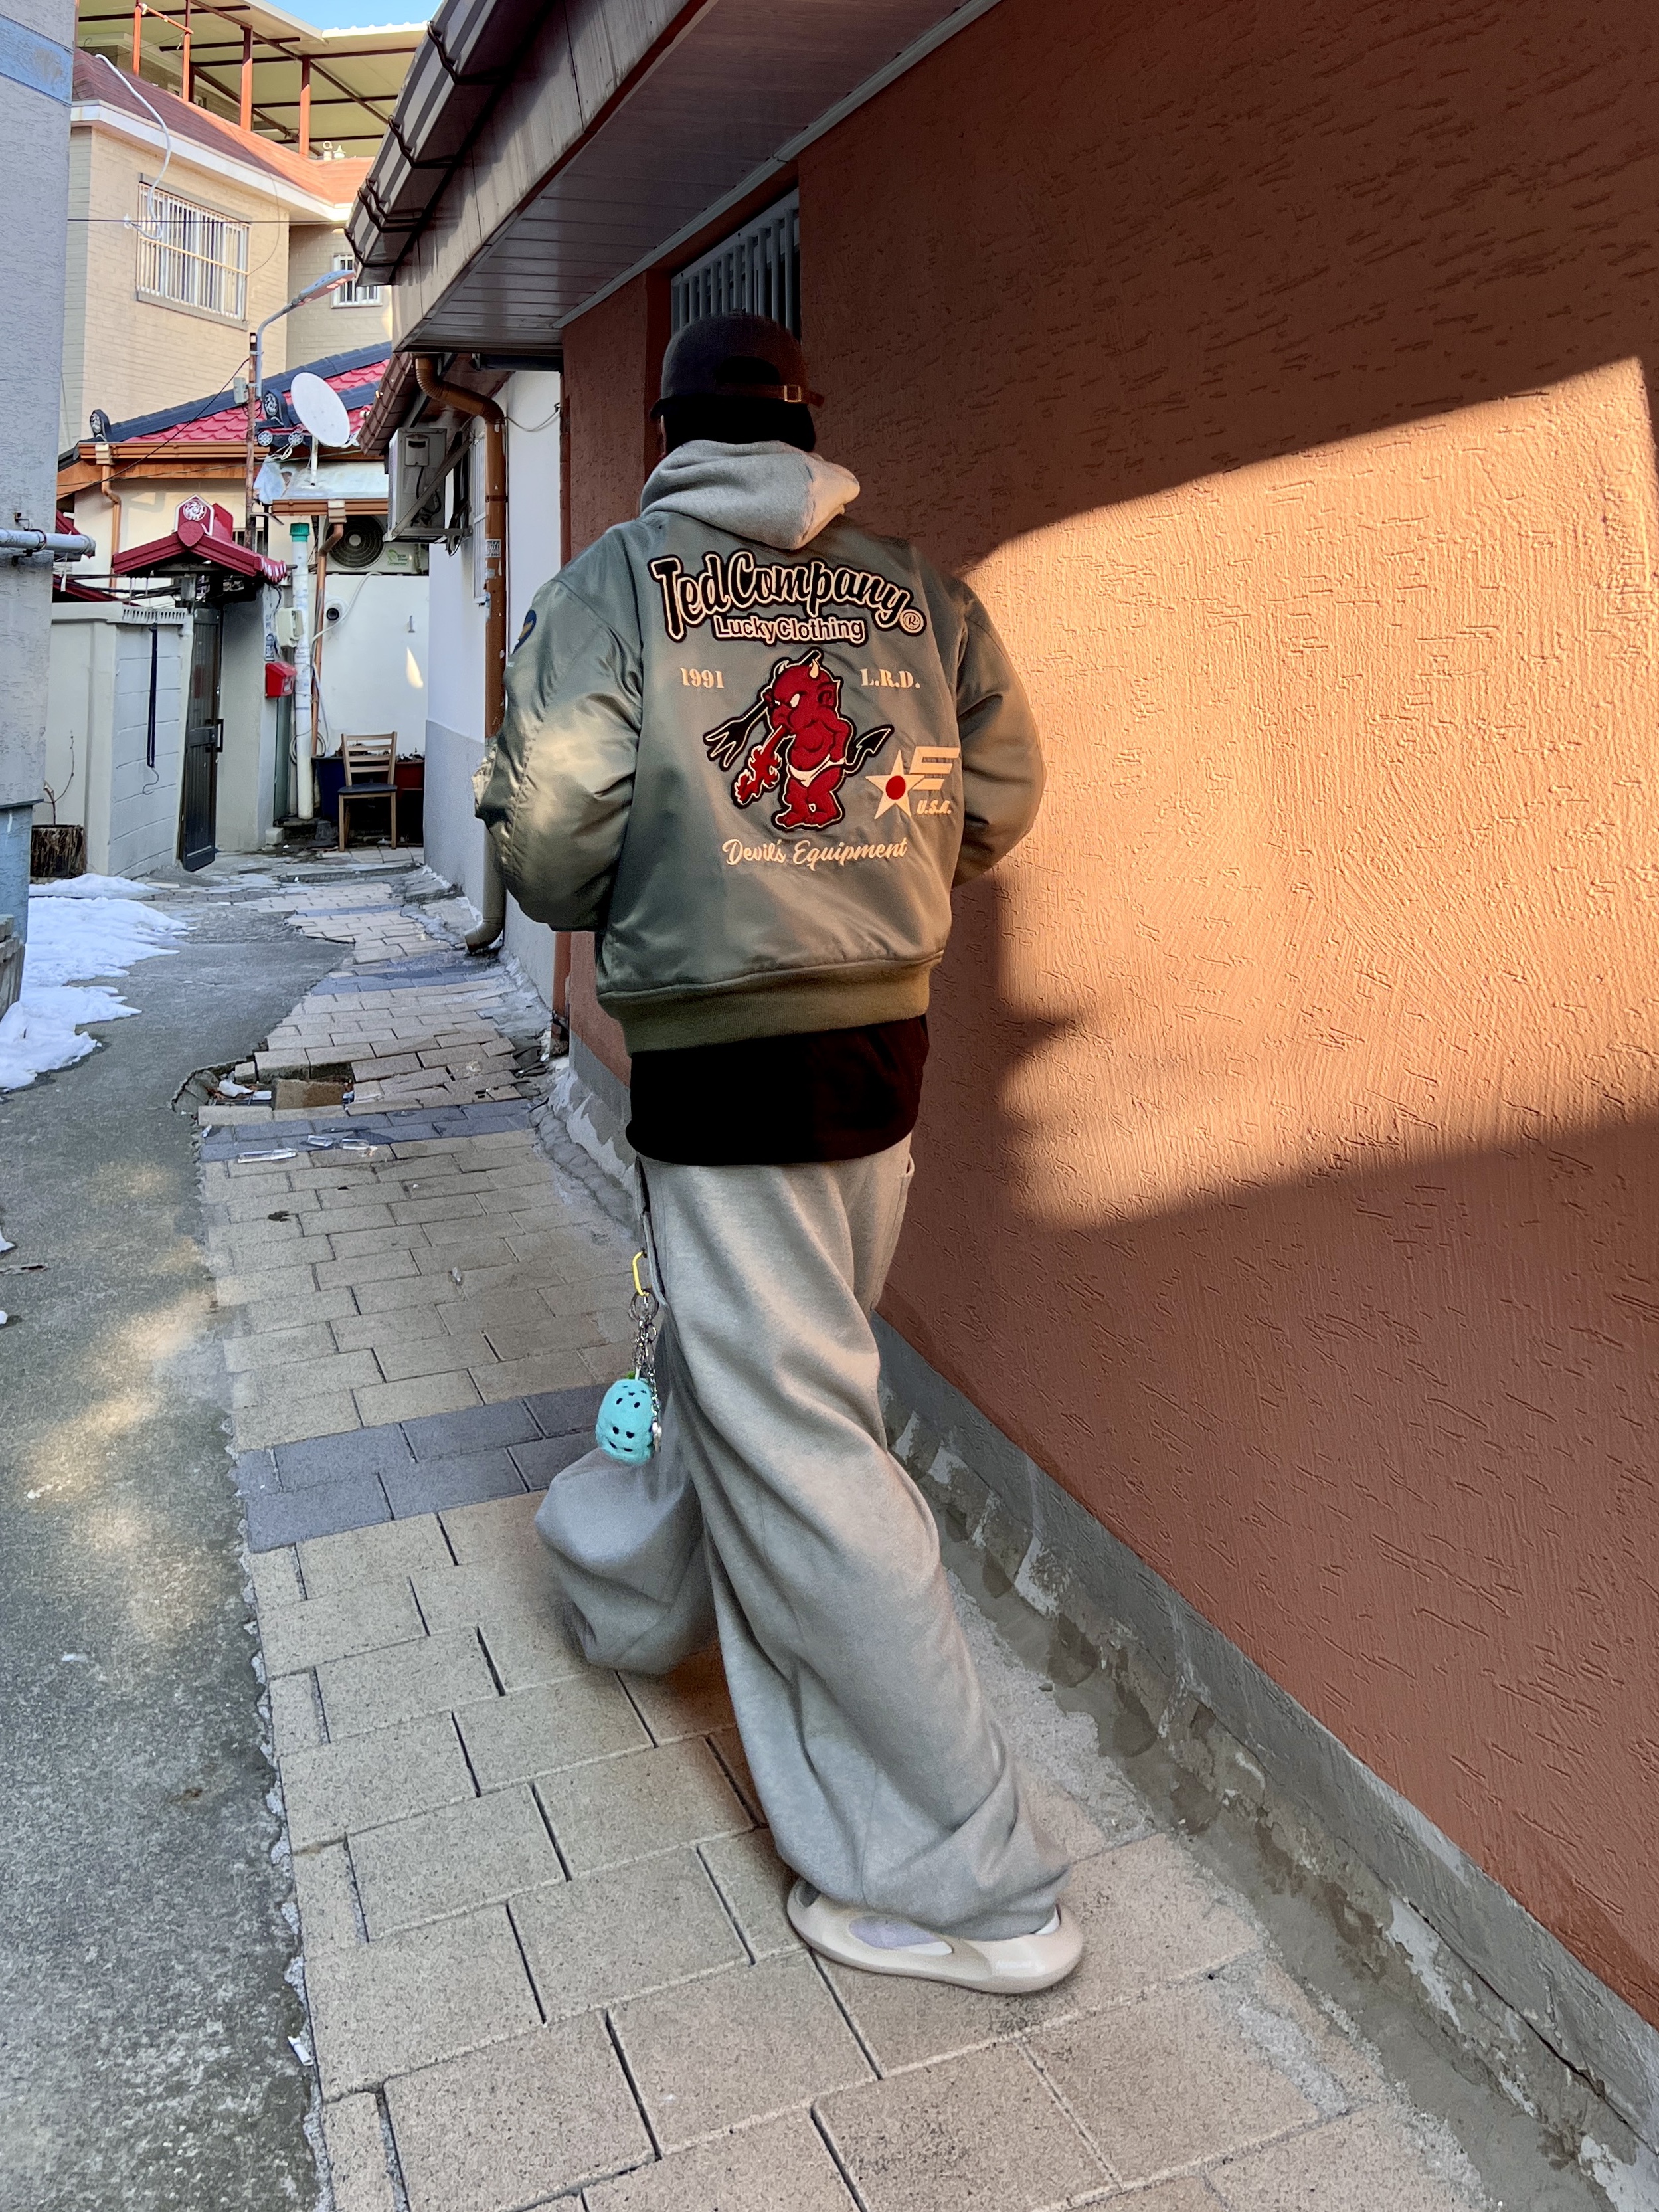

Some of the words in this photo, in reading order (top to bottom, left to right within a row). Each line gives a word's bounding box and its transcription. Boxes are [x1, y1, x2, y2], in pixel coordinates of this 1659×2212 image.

[650, 553, 731, 640] Ted
[728, 551, 911, 628] Company
[679, 667, 725, 689] 1991
[860, 668, 921, 690] L.R.D.
[916, 799, 952, 815] U.S.A.
[722, 838, 786, 866] Devil's
[792, 837, 908, 872] Equipment
